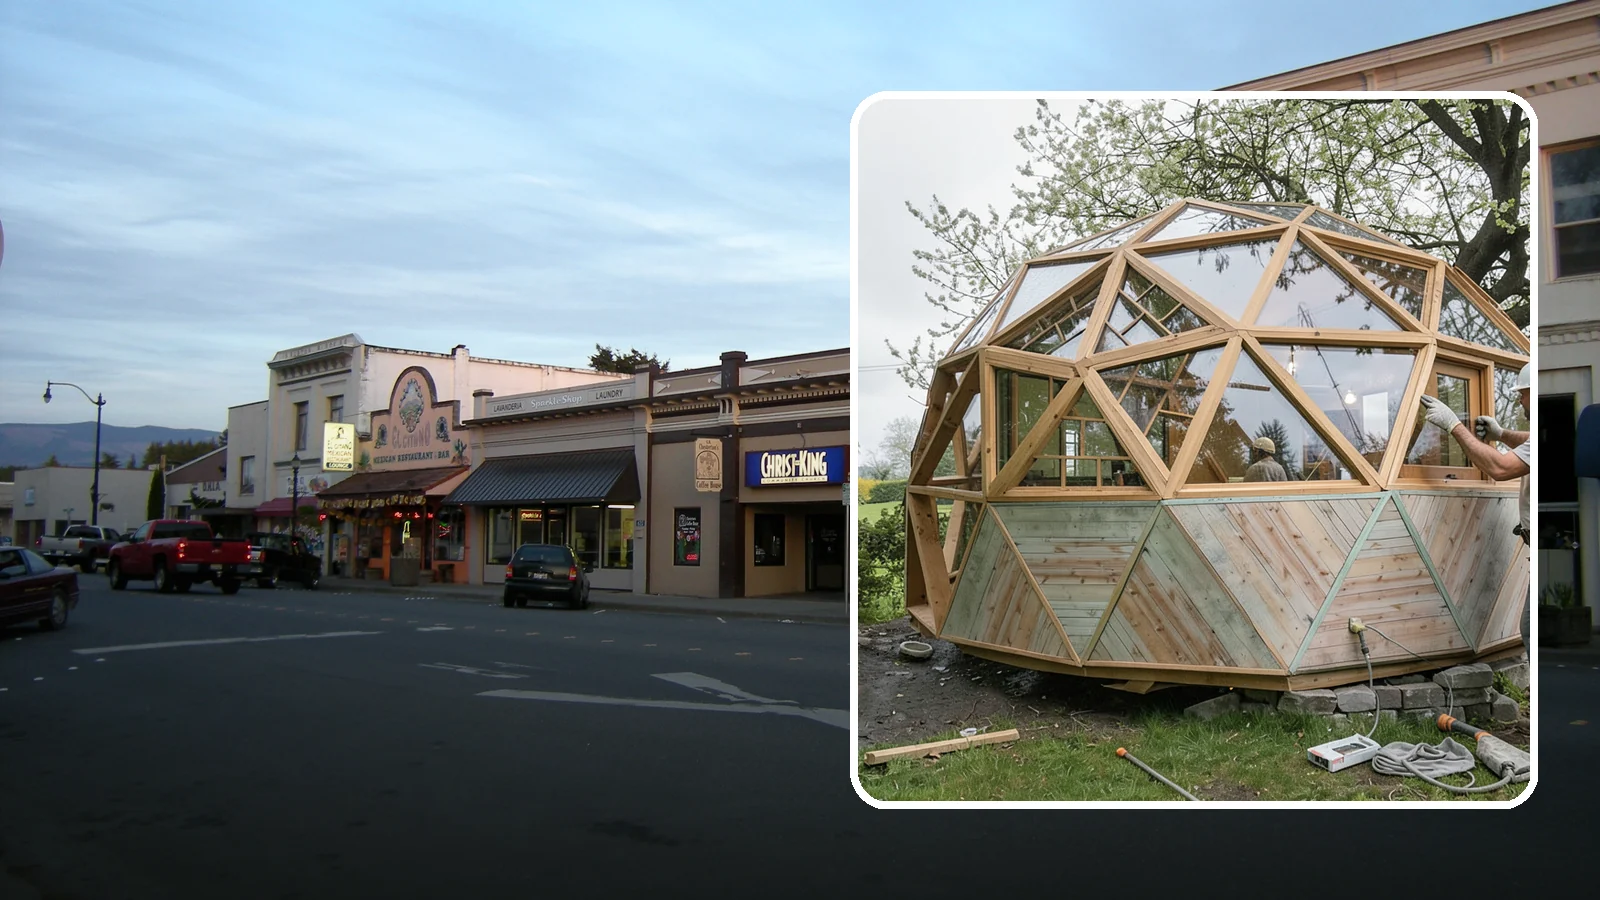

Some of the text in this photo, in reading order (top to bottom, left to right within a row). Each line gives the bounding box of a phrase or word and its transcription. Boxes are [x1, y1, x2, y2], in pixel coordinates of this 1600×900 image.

[531, 394, 583, 409] Sparkle Shop
[595, 389, 624, 400] LAUNDRY
[493, 402, 523, 413] LAVANDERIA
[392, 426, 402, 449] EL
[373, 455, 396, 465] MEXICAN
[398, 451, 433, 462] RESTAURANT
[438, 450, 450, 459] BAR
[760, 450, 827, 478] CHRIST KING
